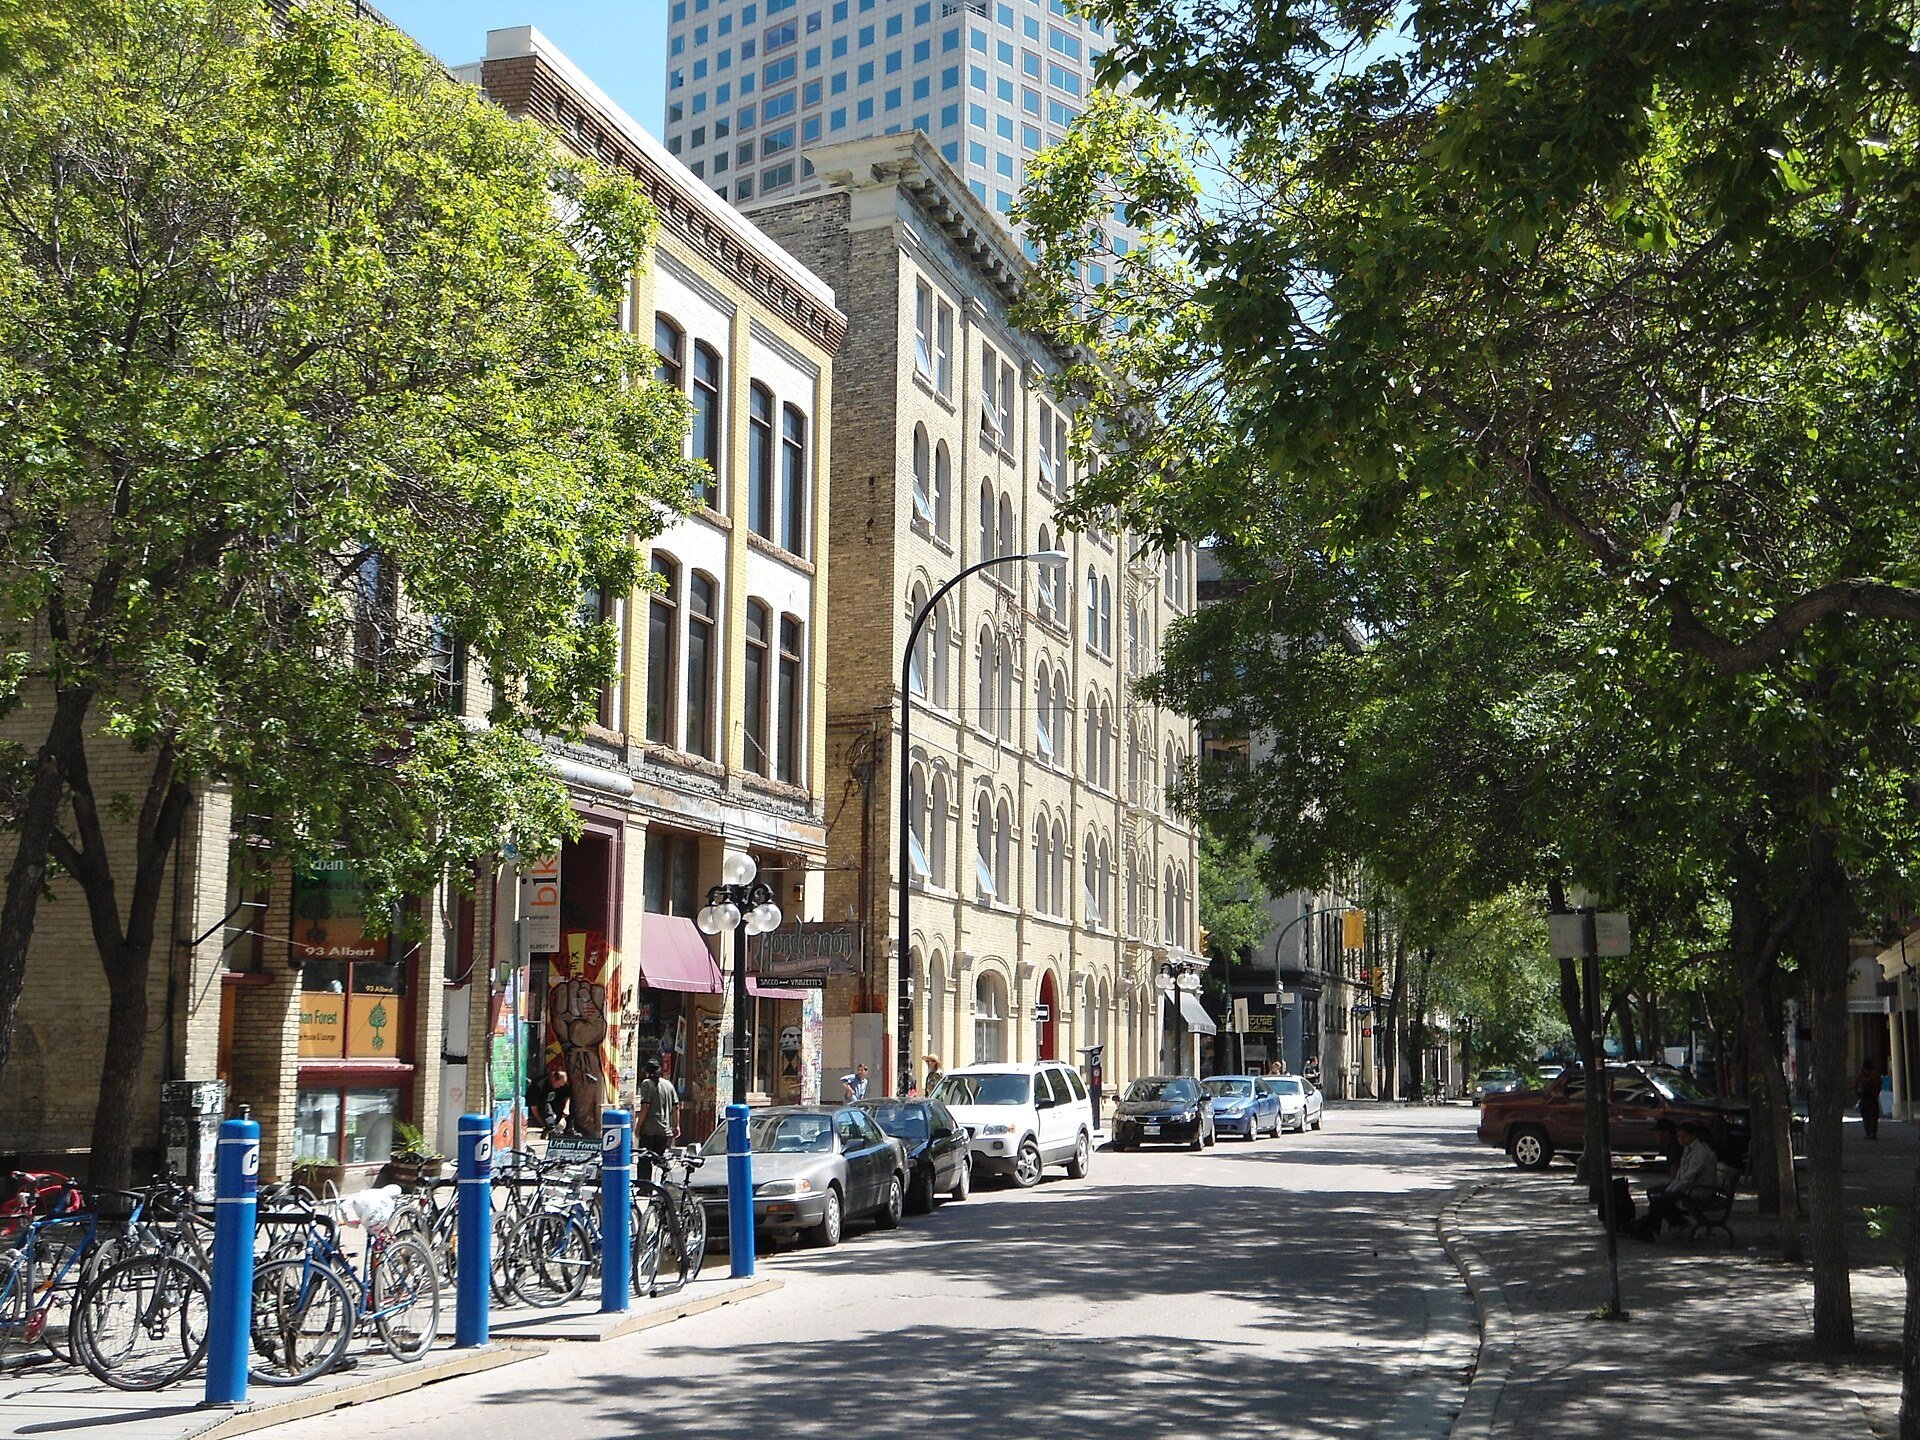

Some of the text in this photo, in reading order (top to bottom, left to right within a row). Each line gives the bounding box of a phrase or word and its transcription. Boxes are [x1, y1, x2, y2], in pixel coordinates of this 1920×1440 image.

[521, 853, 558, 906] bik
[305, 946, 375, 956] 93 Albert
[315, 1009, 337, 1025] Forest
[1093, 1056, 1099, 1065] P
[549, 1139, 575, 1150] Urban
[606, 1135, 615, 1146] P
[481, 1143, 488, 1155] P
[249, 1154, 257, 1169] P
